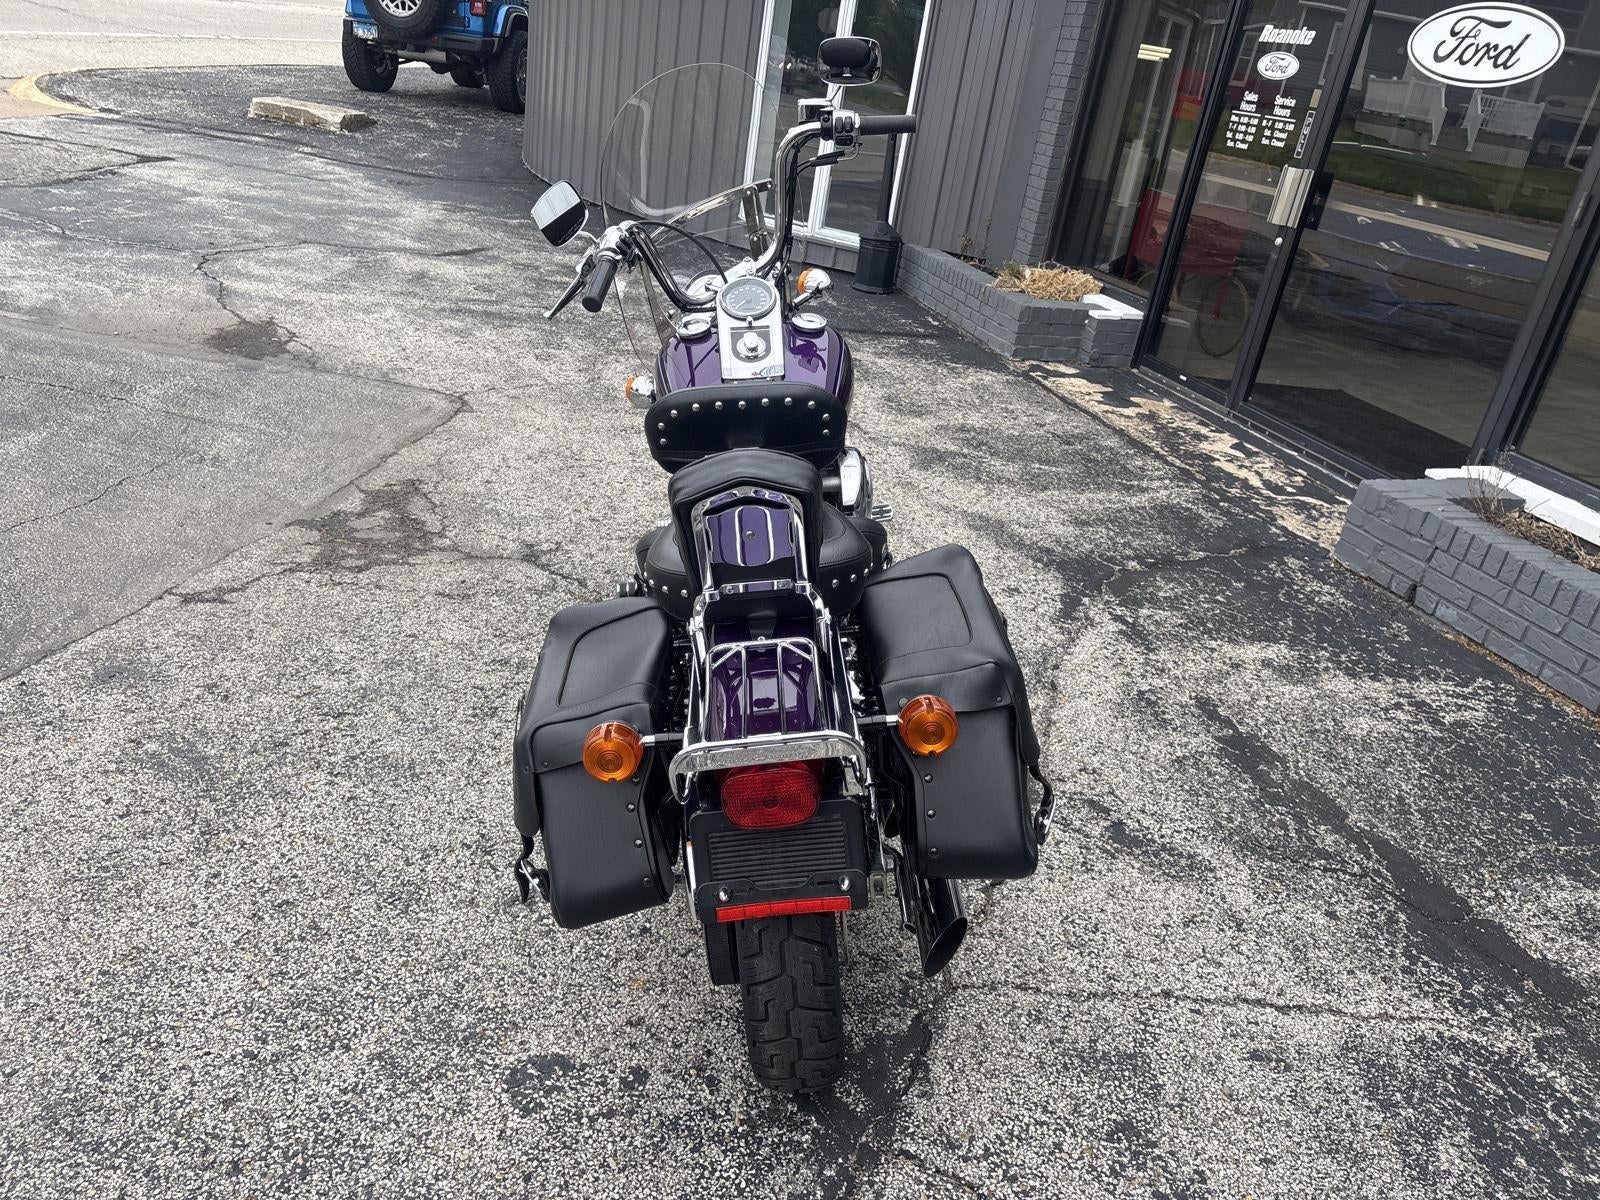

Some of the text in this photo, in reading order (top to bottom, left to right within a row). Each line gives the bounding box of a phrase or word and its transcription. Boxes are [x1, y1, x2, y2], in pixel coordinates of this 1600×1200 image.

[1258, 24, 1317, 46] Roanoke
[1433, 15, 1532, 71] Ford
[1265, 55, 1290, 75] Ford
[1243, 90, 1259, 102] Sales
[1274, 94, 1297, 107] Service
[1239, 101, 1257, 112] Hours
[1272, 106, 1291, 118] Hours
